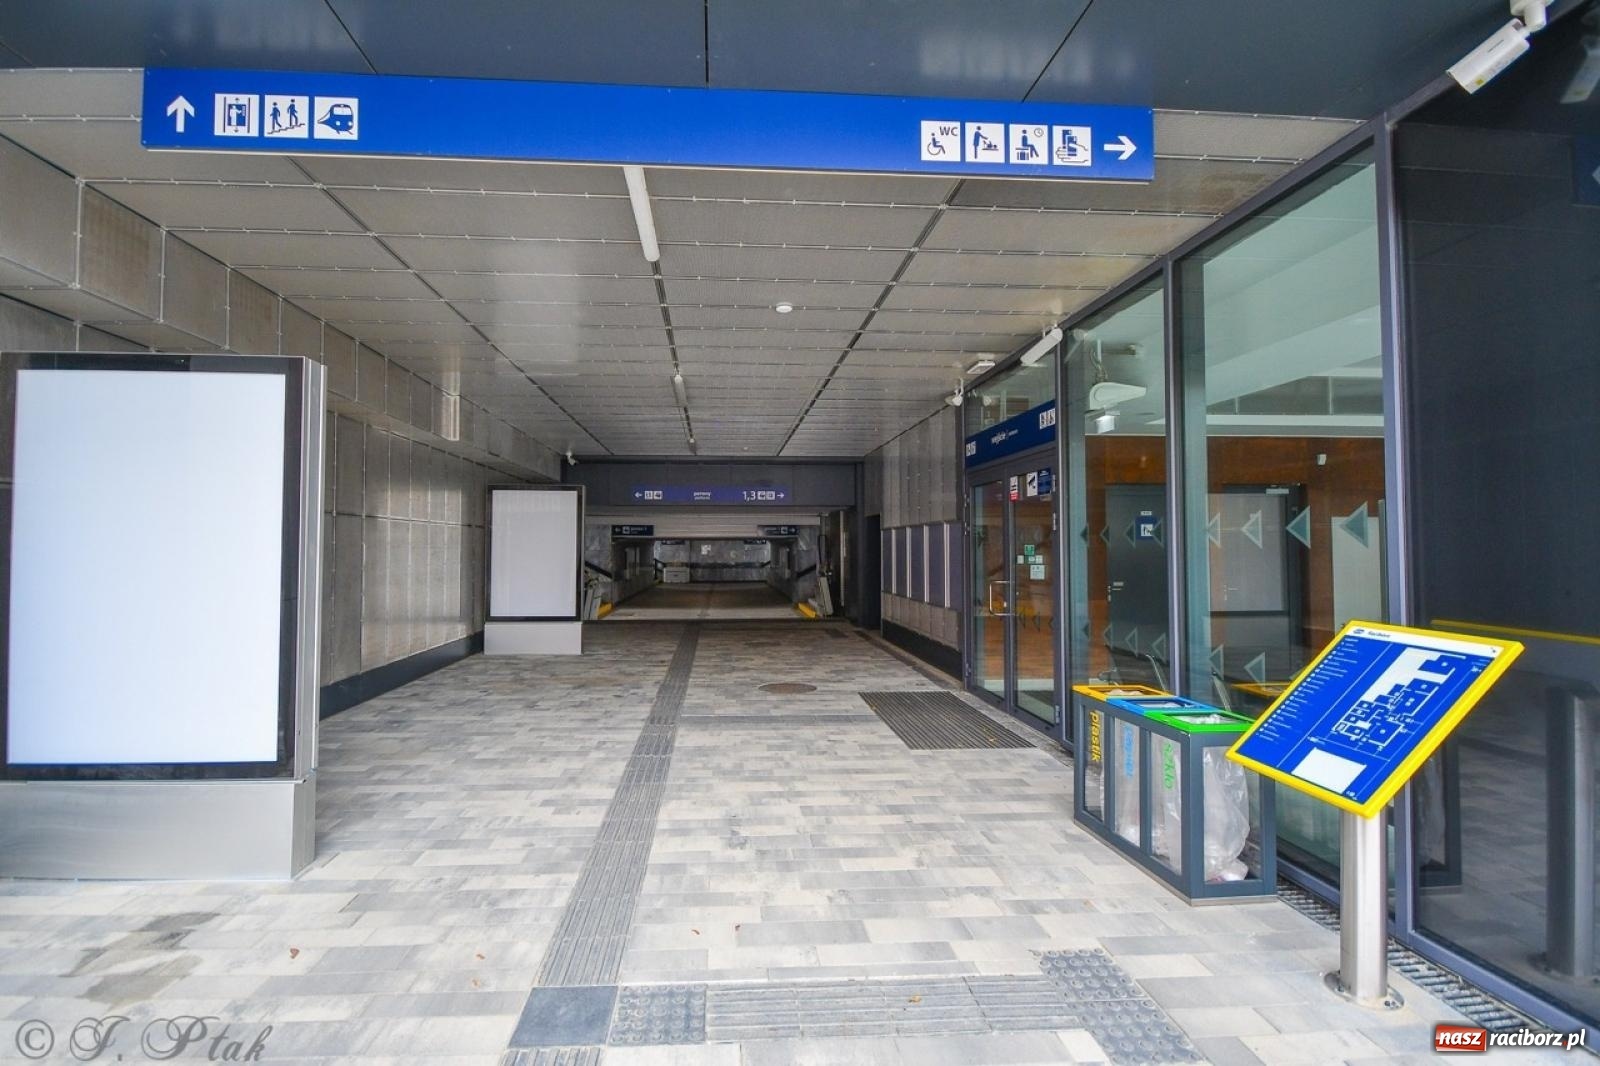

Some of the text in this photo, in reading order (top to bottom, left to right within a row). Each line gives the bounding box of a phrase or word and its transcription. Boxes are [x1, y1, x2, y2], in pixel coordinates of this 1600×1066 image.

[939, 126, 958, 137] WC
[742, 490, 756, 501] 1,3
[1090, 711, 1102, 761] plastik
